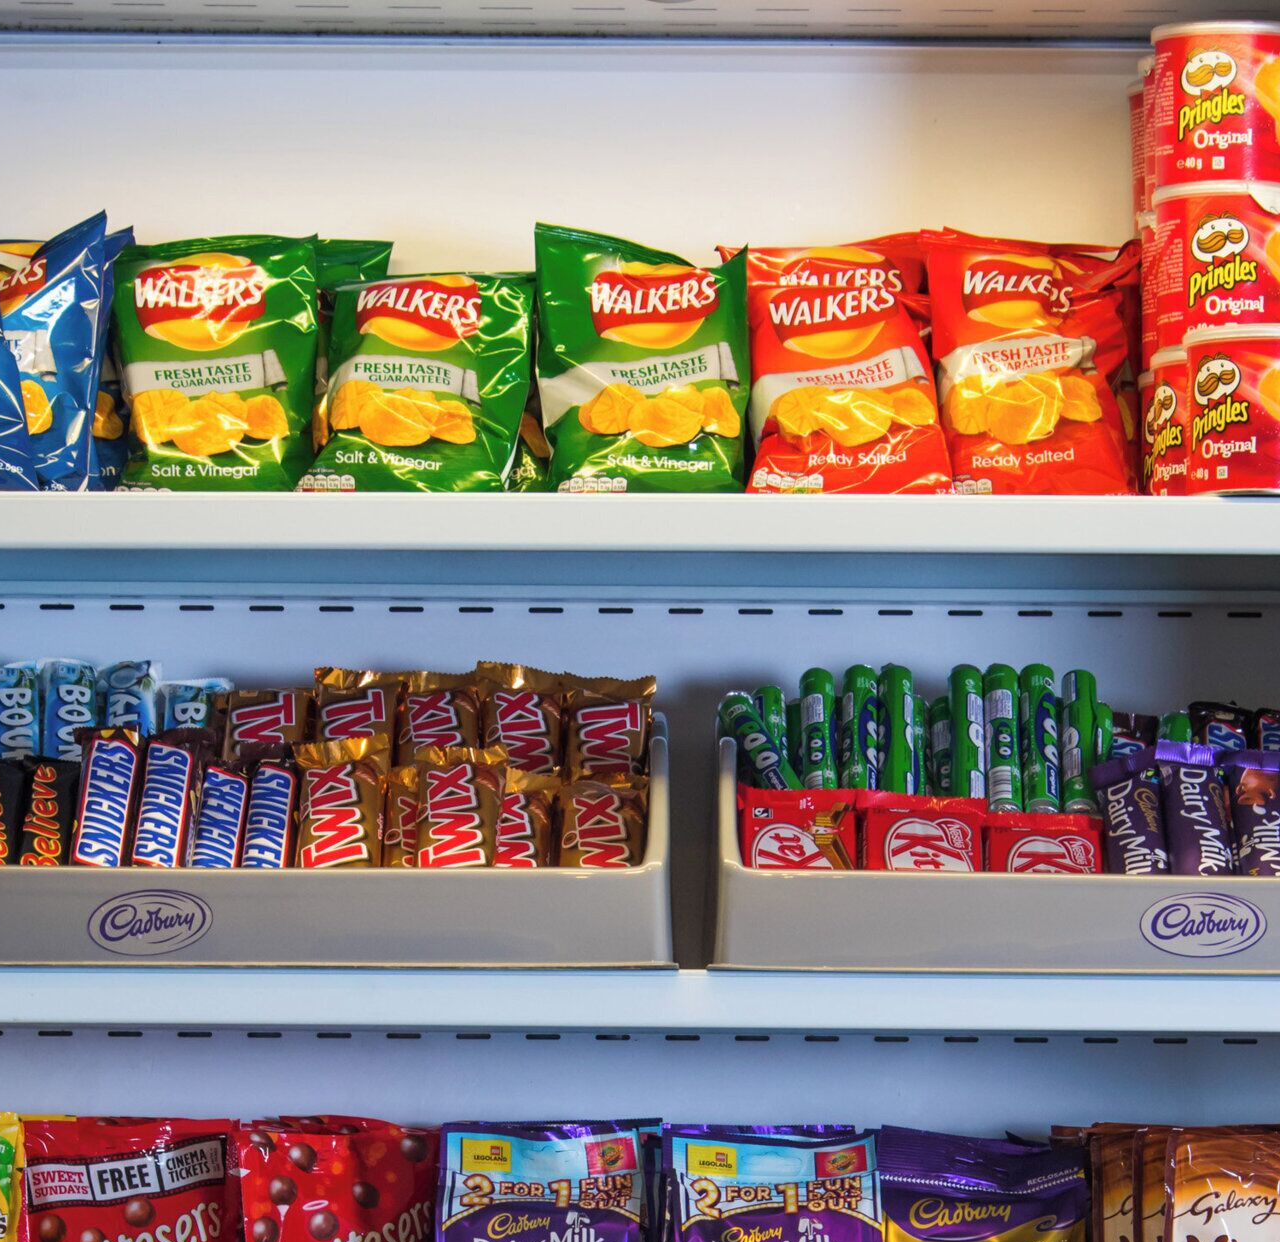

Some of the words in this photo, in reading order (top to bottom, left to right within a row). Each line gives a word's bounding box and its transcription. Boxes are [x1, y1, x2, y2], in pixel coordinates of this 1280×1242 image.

[1178, 89, 1245, 140] Pringles
[1194, 129, 1252, 149] Original
[135, 277, 265, 310] WALKERS
[592, 276, 716, 314] WALKERS
[1189, 257, 1257, 308] Pringles
[357, 287, 482, 325] WALKERS
[770, 288, 895, 326] WALKERS
[155, 365, 201, 381] FRESH
[205, 362, 250, 377] TASTE
[171, 374, 252, 389] GUARANTEED
[354, 363, 406, 374] FRESH
[408, 364, 451, 379] TASTE
[368, 374, 451, 386] GUARANTEED
[1192, 400, 1249, 450] Pringles
[335, 450, 366, 465] Salt
[368, 453, 378, 465] &
[380, 452, 442, 472] Vinegar
[972, 454, 1021, 468] Ready
[1025, 448, 1075, 465] Salted
[1202, 437, 1257, 459] Original
[152, 464, 183, 477] Salt
[186, 465, 195, 477] &
[198, 464, 260, 479] Vinegar
[77, 739, 135, 866] SNICKERS
[134, 743, 189, 867] SNICKERS
[1180, 767, 1212, 824] Dairy
[302, 763, 368, 868] TWIX
[418, 763, 486, 867] TWIX
[1194, 823, 1228, 876] Milk
[100, 904, 195, 941] Cadbury
[1151, 903, 1249, 940] Cadbury
[166, 1149, 207, 1169] CINEMA
[168, 1163, 211, 1182] TICKETS
[474, 1154, 507, 1163] LEGOLAND
[32, 1168, 84, 1185] SWEET
[35, 1183, 88, 1198] SUNDAYS
[97, 1166, 151, 1195] FREE
[460, 1173, 495, 1207] 2
[499, 1181, 545, 1197] FOR
[548, 1179, 571, 1208] 1
[909, 1199, 1011, 1229] Cadbury
[1189, 1191, 1277, 1225] Galaxy
[487, 1213, 550, 1239] Cadbury
